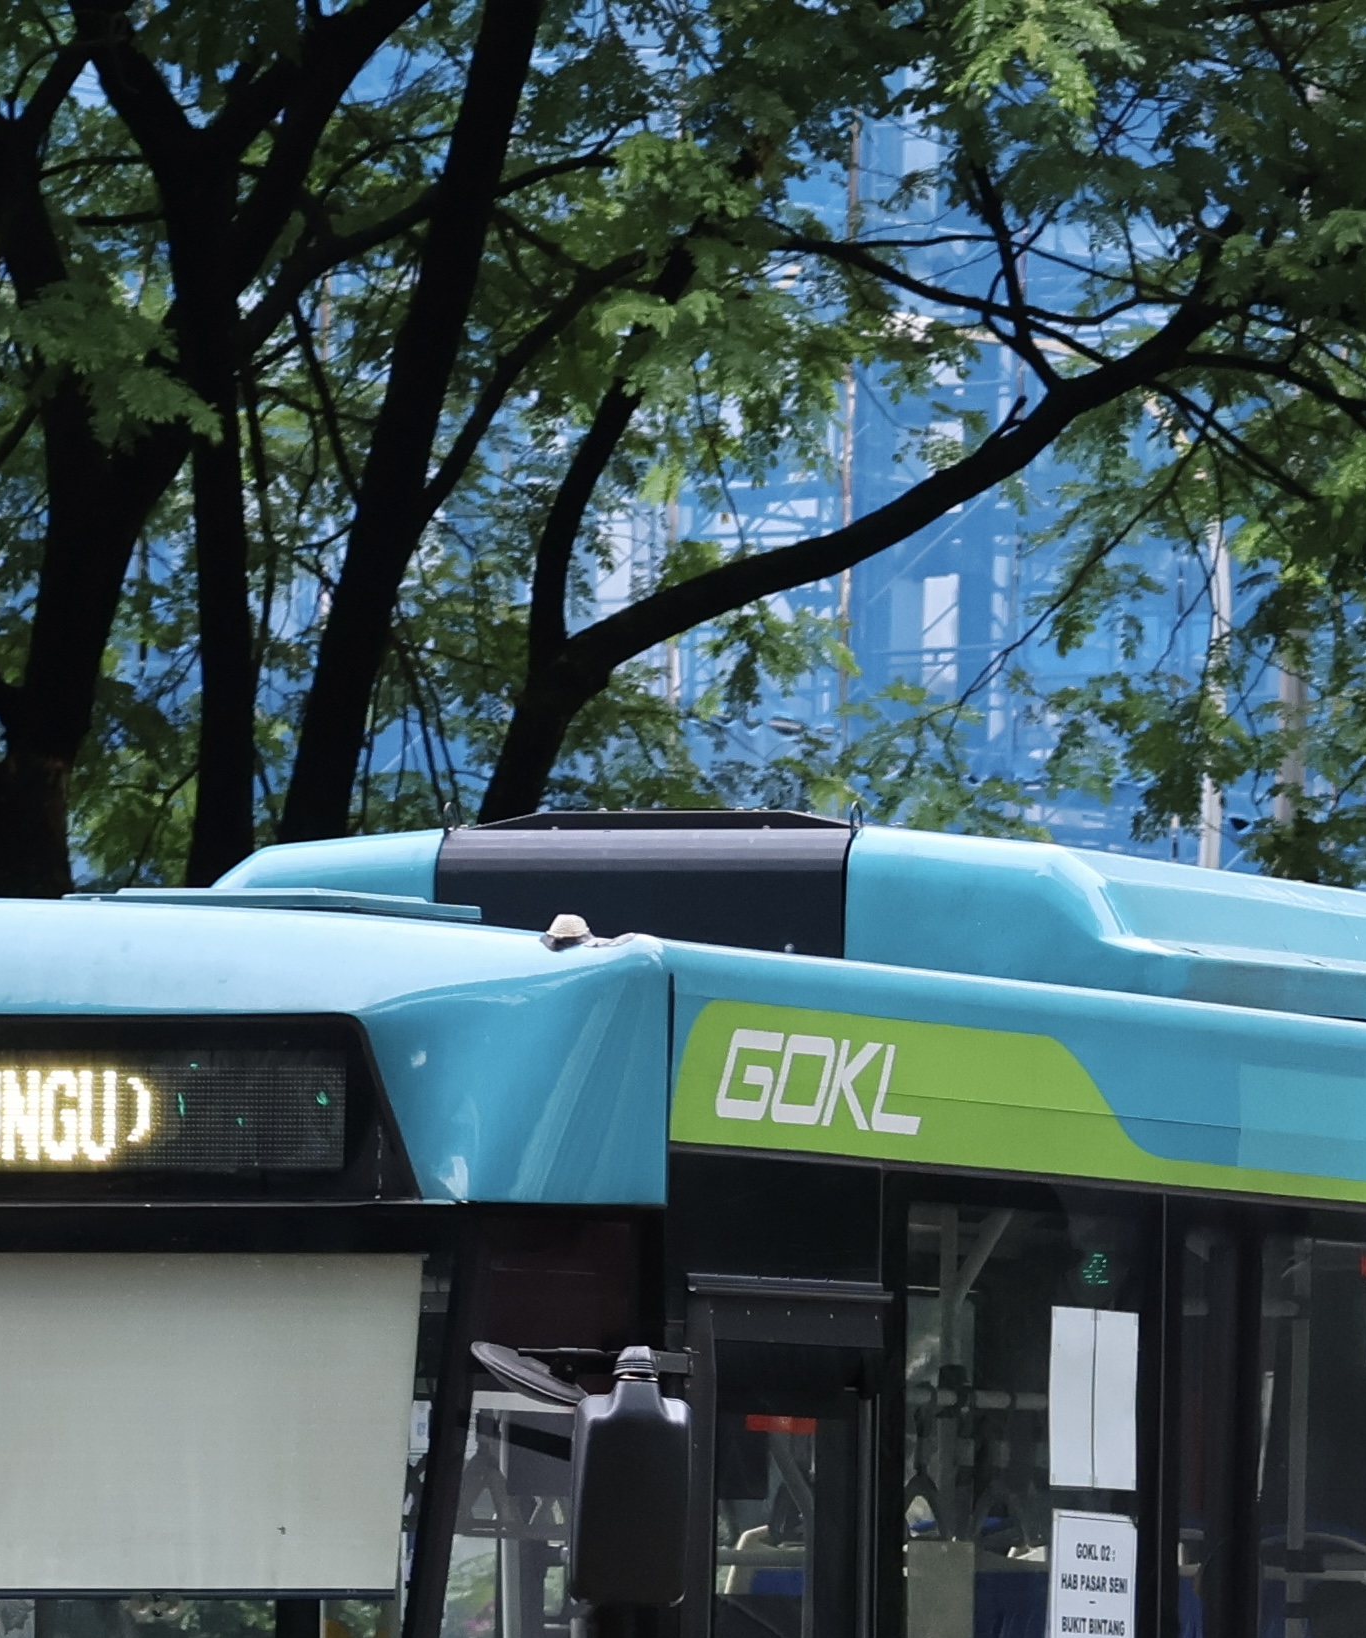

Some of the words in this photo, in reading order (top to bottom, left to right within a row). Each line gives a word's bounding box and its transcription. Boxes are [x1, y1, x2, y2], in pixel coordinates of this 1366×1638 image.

[715, 1028, 922, 1135] GOKL
[1076, 1543, 1099, 1562] GOKL
[1100, 1546, 1111, 1562] 02
[1061, 1573, 1079, 1591] HAB
[1080, 1575, 1108, 1593] PASAR
[1109, 1577, 1129, 1595] SENI
[1061, 1616, 1087, 1634] BUKIT
[1088, 1618, 1126, 1637] BINTANG
